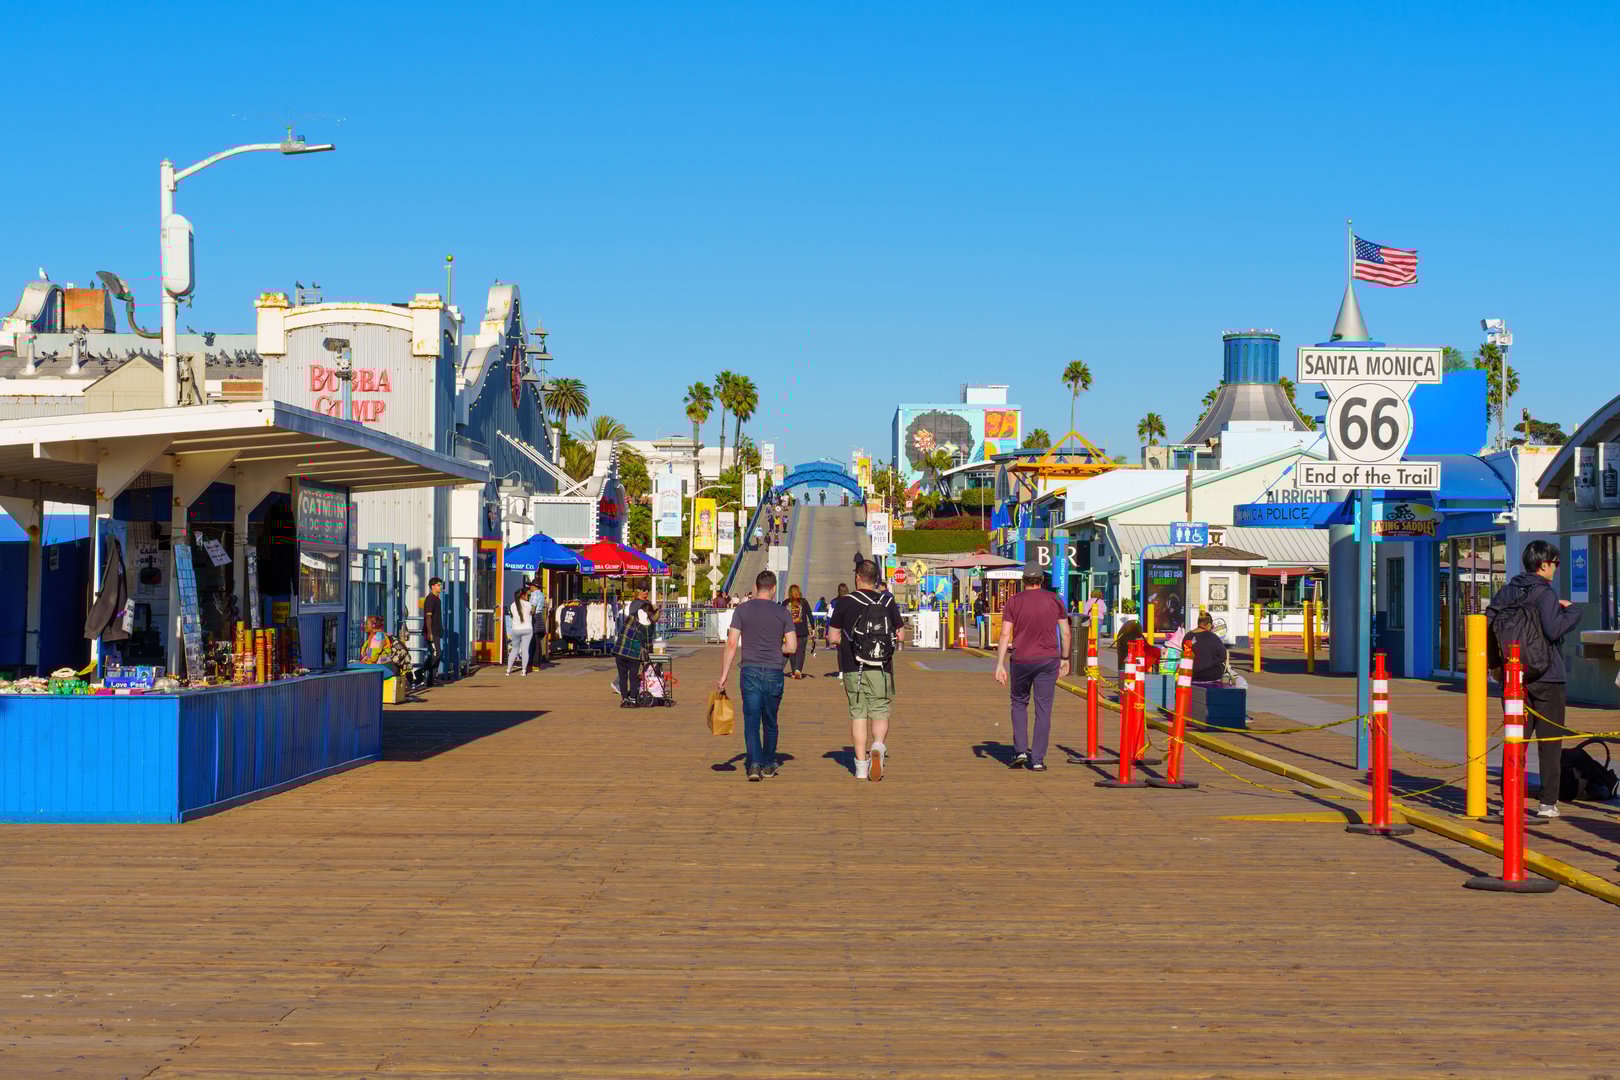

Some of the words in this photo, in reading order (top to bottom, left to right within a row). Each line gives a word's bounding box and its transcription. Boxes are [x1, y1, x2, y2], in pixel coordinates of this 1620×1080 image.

[1305, 354, 1359, 375] SANTA
[1366, 356, 1436, 376] MONICA
[1339, 397, 1400, 451] 66
[1305, 466, 1336, 483] End
[1342, 466, 1359, 484] of
[1365, 466, 1391, 484] the
[1397, 467, 1432, 485] Trail
[1266, 507, 1310, 520] POLICE
[873, 524, 887, 532] SAVE
[1371, 520, 1400, 534] LAZING
[1401, 519, 1436, 537] SADDLES
[1037, 546, 1080, 567] BR
